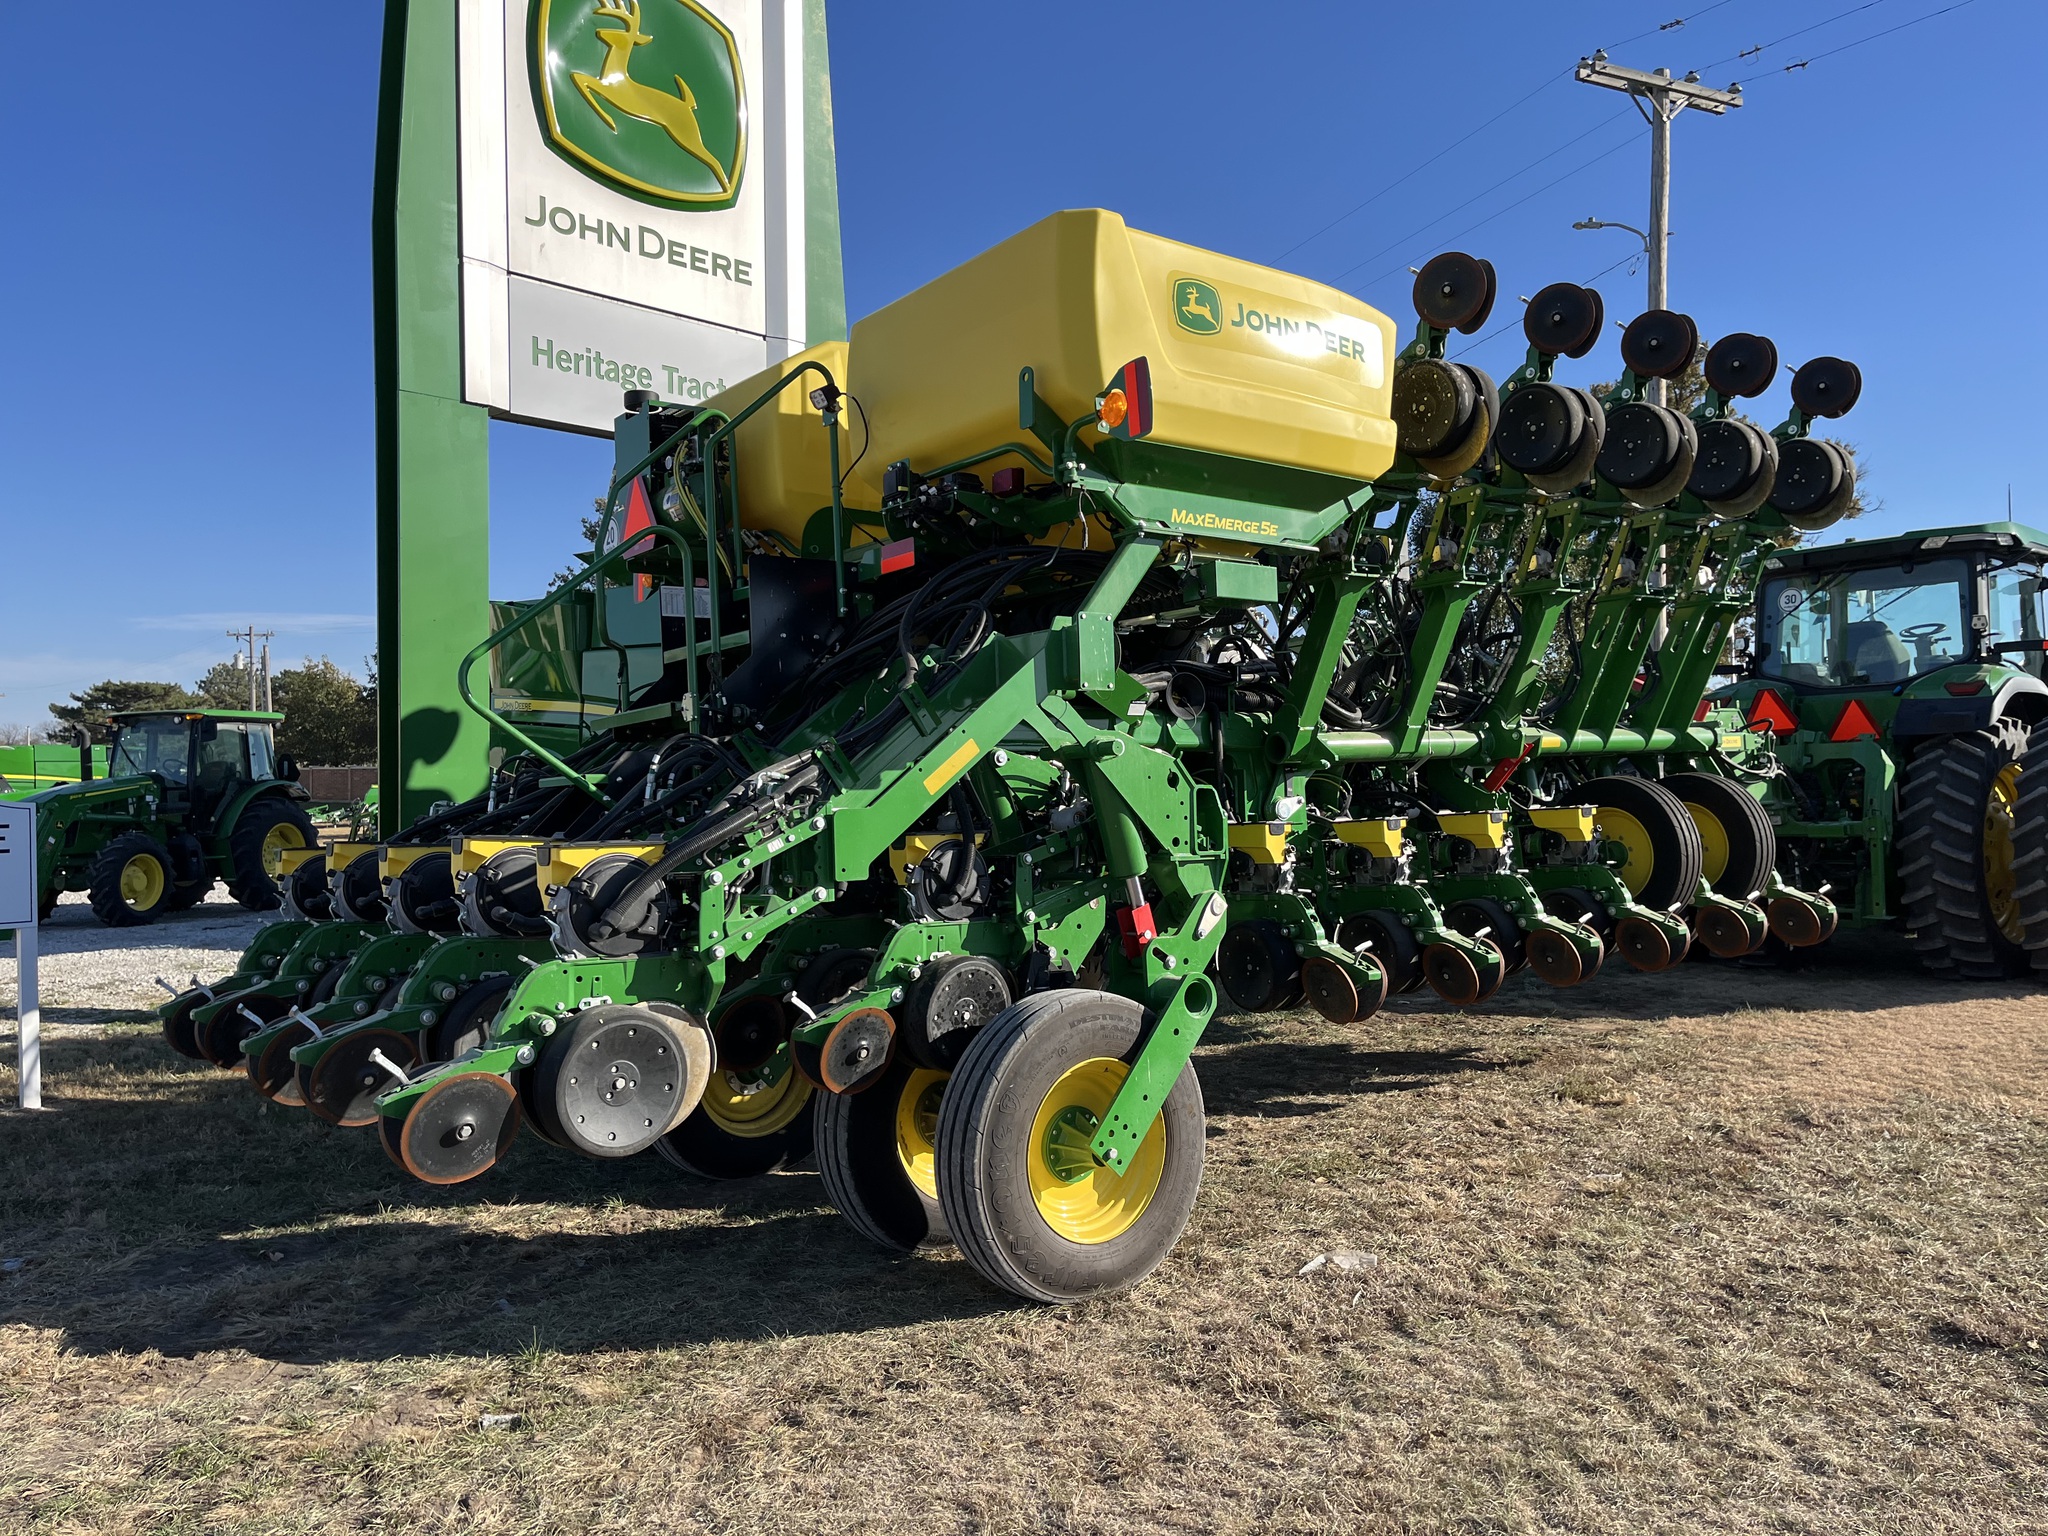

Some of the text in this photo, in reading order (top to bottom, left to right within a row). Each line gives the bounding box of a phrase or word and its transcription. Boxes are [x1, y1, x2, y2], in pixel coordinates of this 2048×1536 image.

[525, 195, 753, 287] JOHN DEERE
[1231, 302, 1300, 337] JOHN
[531, 335, 653, 391] Heritage
[1784, 594, 1797, 605] 30
[500, 700, 533, 712] JOHN DEERE
